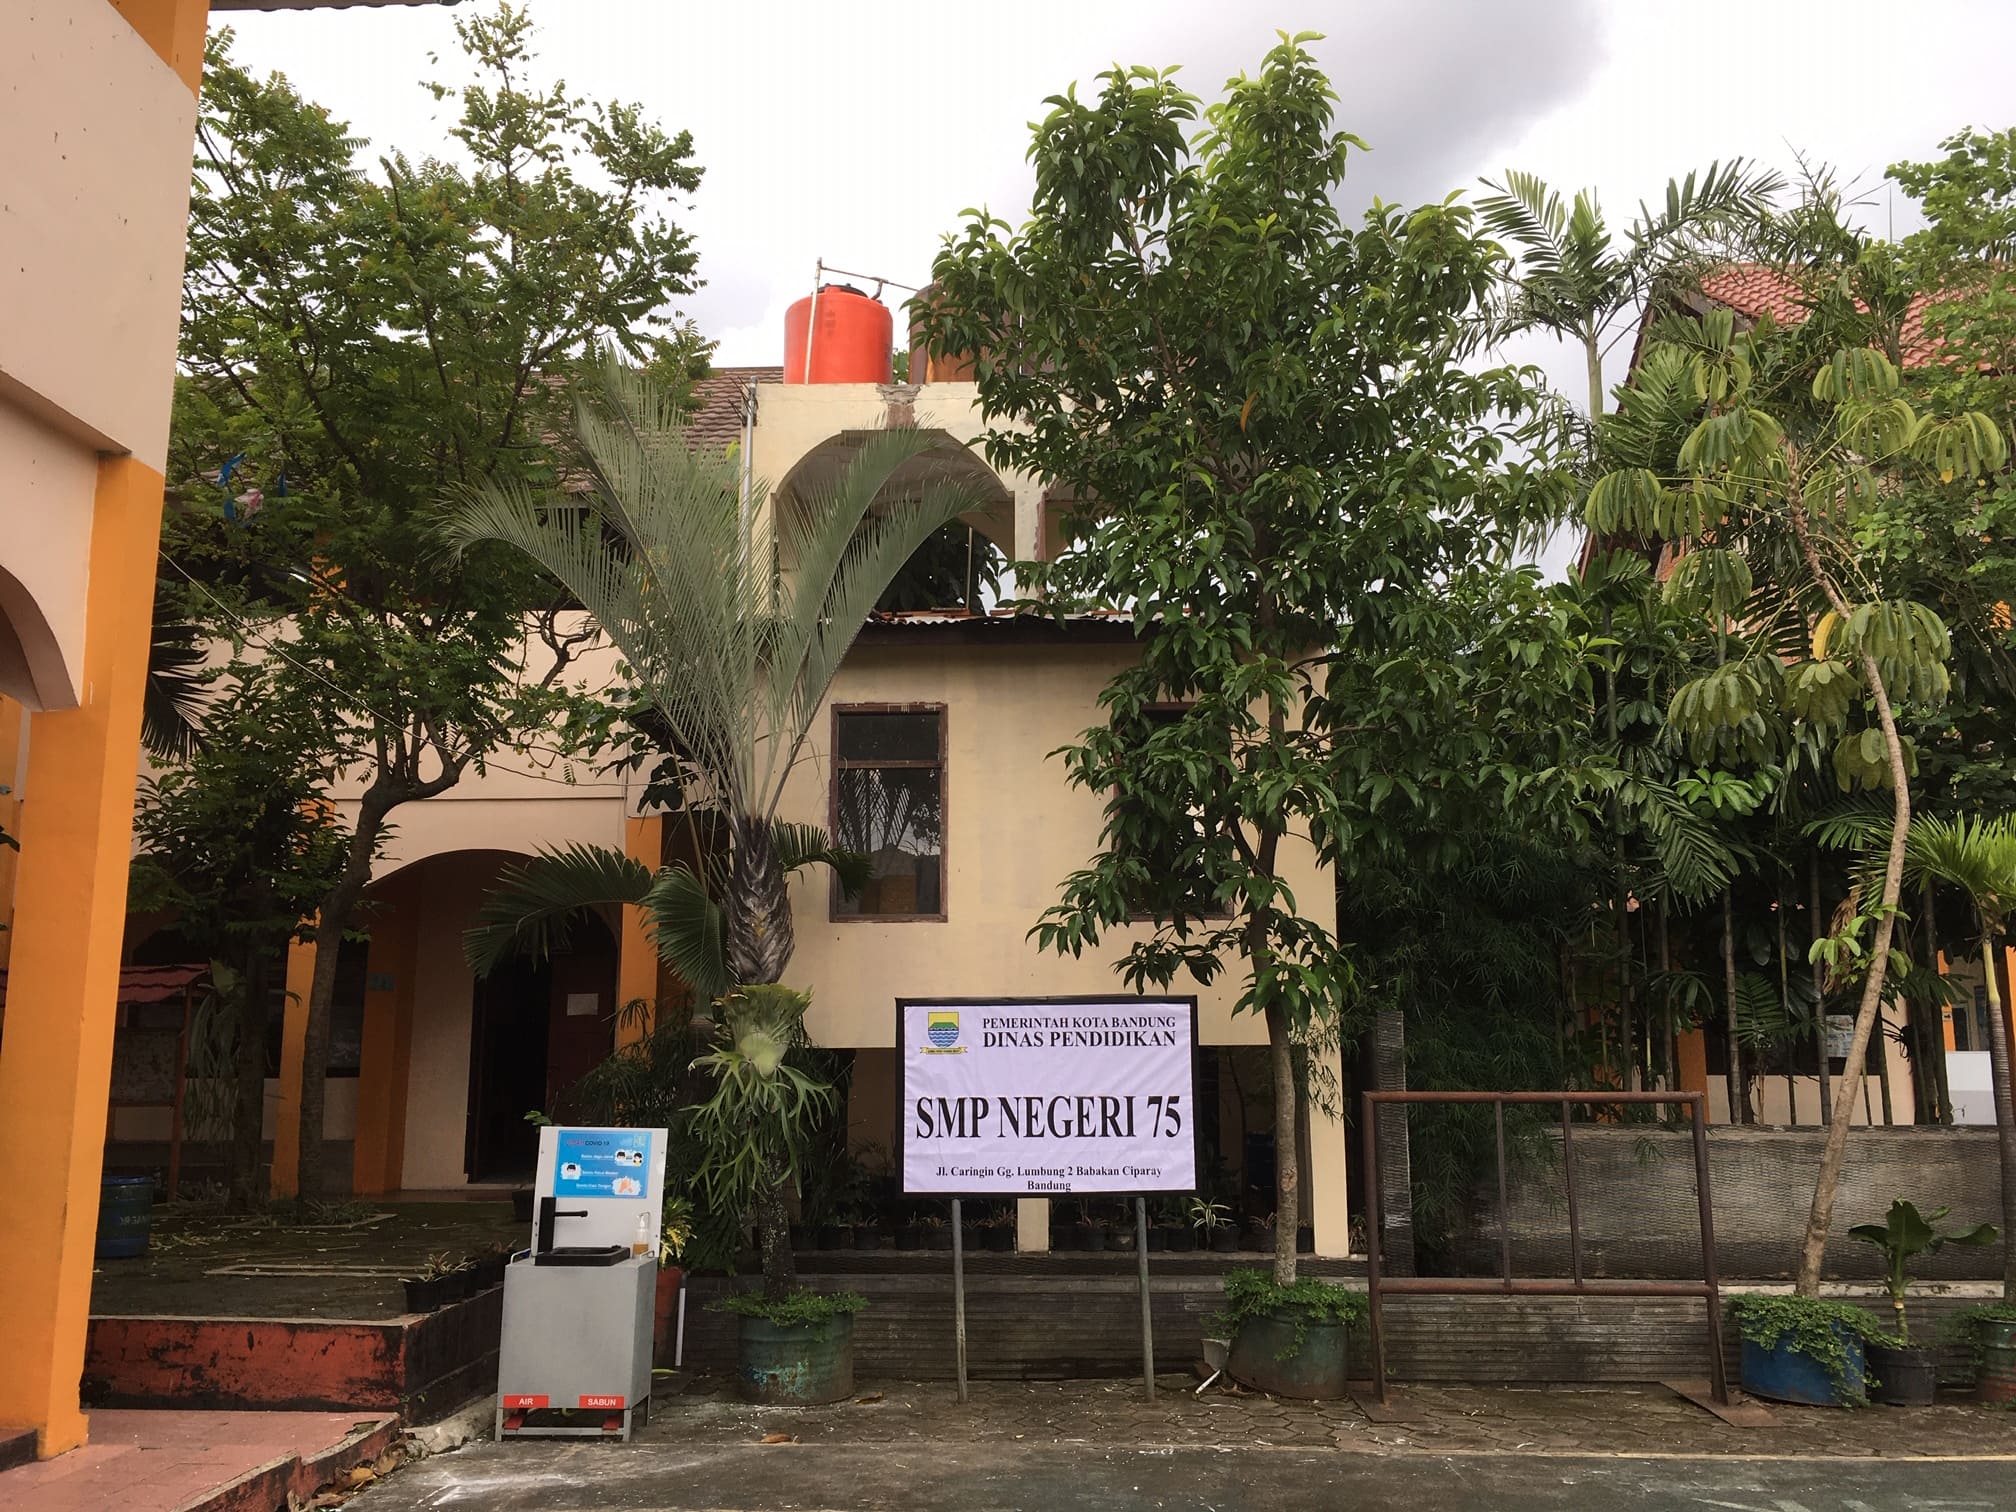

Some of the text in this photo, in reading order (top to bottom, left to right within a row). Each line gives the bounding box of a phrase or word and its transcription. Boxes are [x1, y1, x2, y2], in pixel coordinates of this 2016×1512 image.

[983, 1016, 1176, 1029] PEMERINTAH KOTA BANDUNG
[983, 1030, 1177, 1048] DINAS PENDIDIKAN
[916, 1095, 1181, 1139] SMP NEGERI 75
[935, 1165, 1162, 1178] Jl. Caringin Gg. Lumbung 2 Babakan Ciparay
[1027, 1180, 1072, 1192] Bandung
[587, 1398, 616, 1407] SABUN
